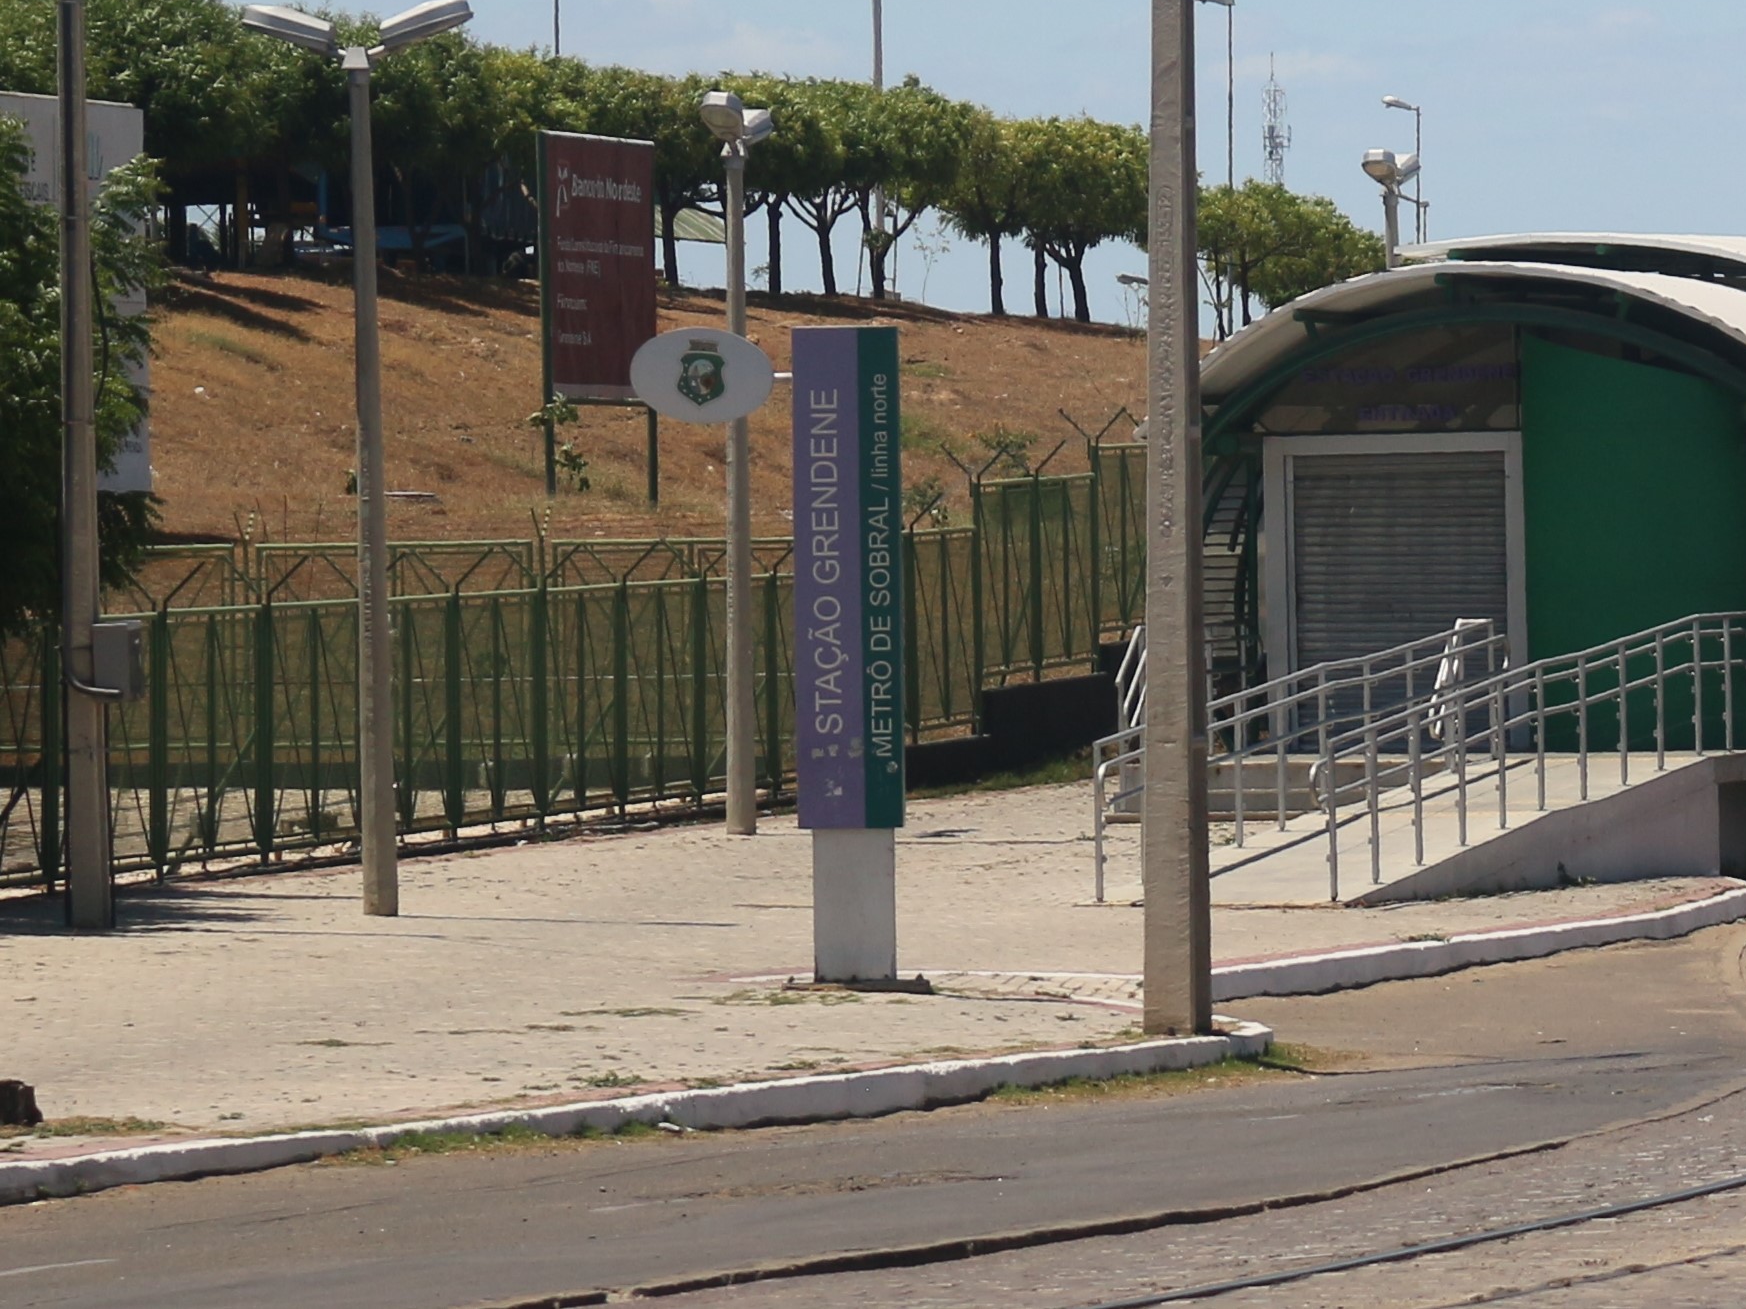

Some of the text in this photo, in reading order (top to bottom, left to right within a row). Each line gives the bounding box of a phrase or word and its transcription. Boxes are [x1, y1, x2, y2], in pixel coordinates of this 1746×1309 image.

[870, 373, 887, 424] norte
[810, 388, 841, 584] GRENDENE
[870, 430, 889, 477] linha
[867, 497, 891, 606] SOBRAL
[870, 615, 892, 651] DE
[866, 660, 893, 757] METRÔ
